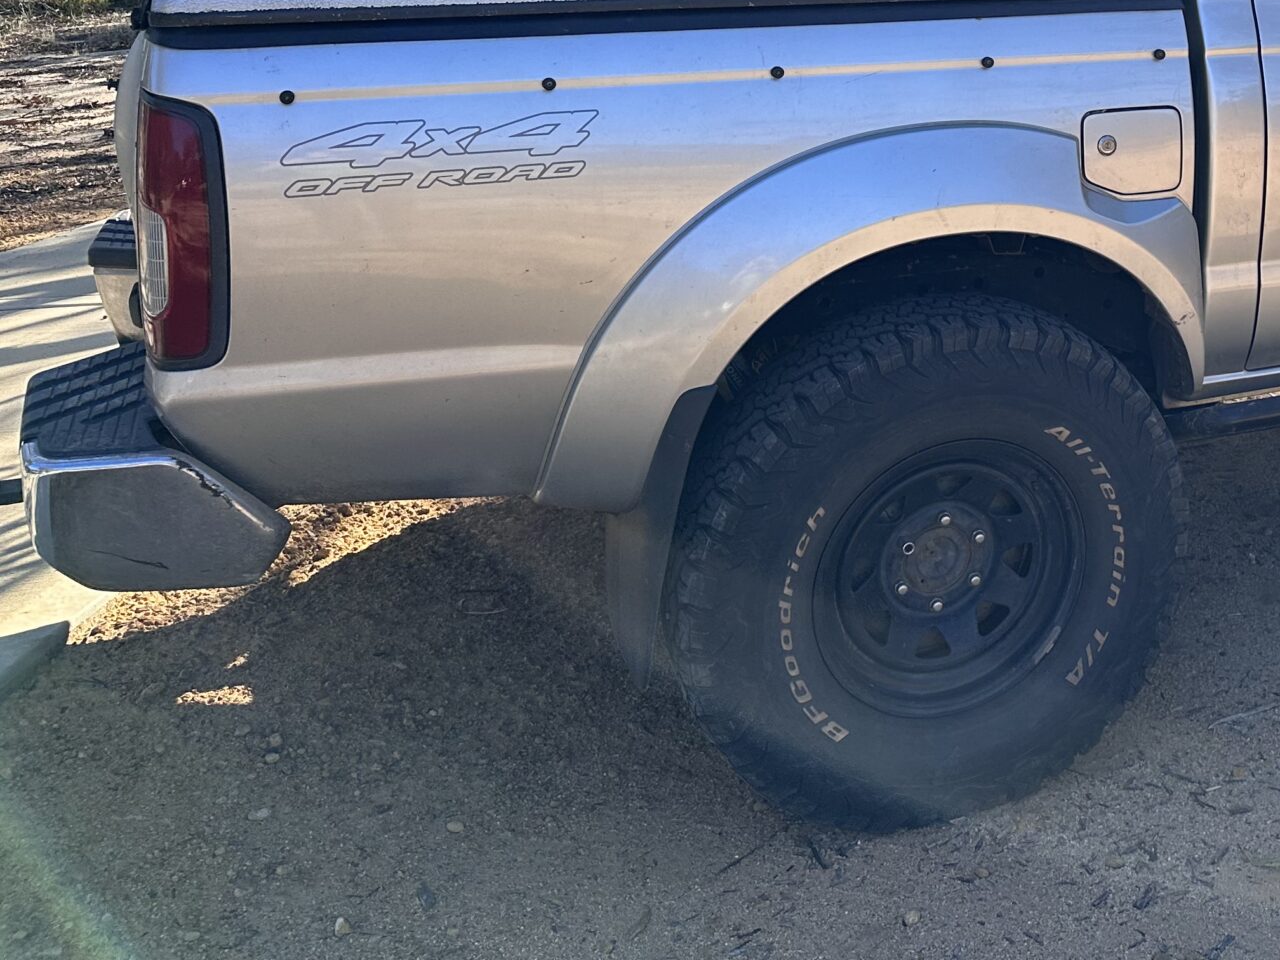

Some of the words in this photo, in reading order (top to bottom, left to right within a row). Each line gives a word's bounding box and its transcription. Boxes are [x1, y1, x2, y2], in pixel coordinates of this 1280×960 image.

[280, 109, 599, 169] 4x4
[284, 172, 413, 198] OFF
[417, 160, 586, 189] ROAD
[1044, 426, 1126, 607] All-Terrain
[778, 506, 849, 742] BFGoodrich
[1065, 628, 1109, 685] T/A
